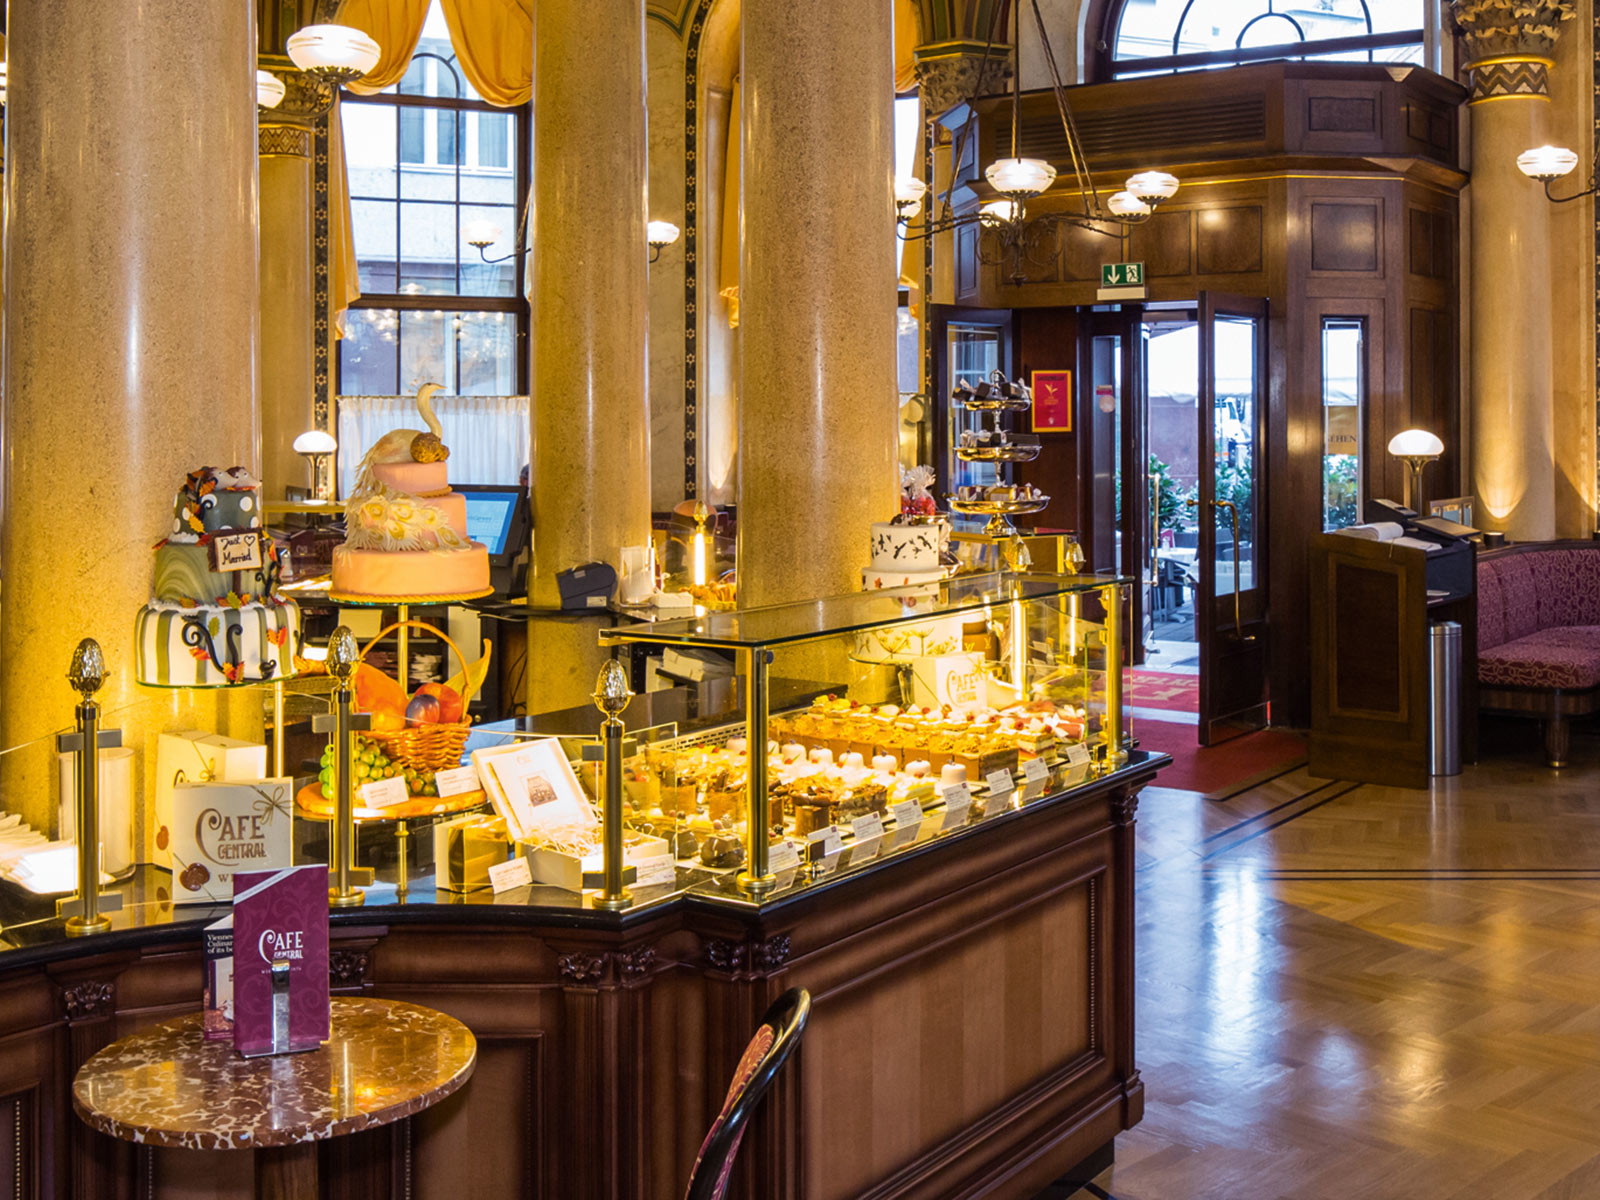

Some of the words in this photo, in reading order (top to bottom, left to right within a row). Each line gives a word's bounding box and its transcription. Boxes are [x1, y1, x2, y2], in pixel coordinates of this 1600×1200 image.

[222, 548, 252, 565] Married
[195, 808, 265, 866] CAFE
[217, 843, 267, 859] CENTRAL
[258, 929, 304, 964] CAFE
